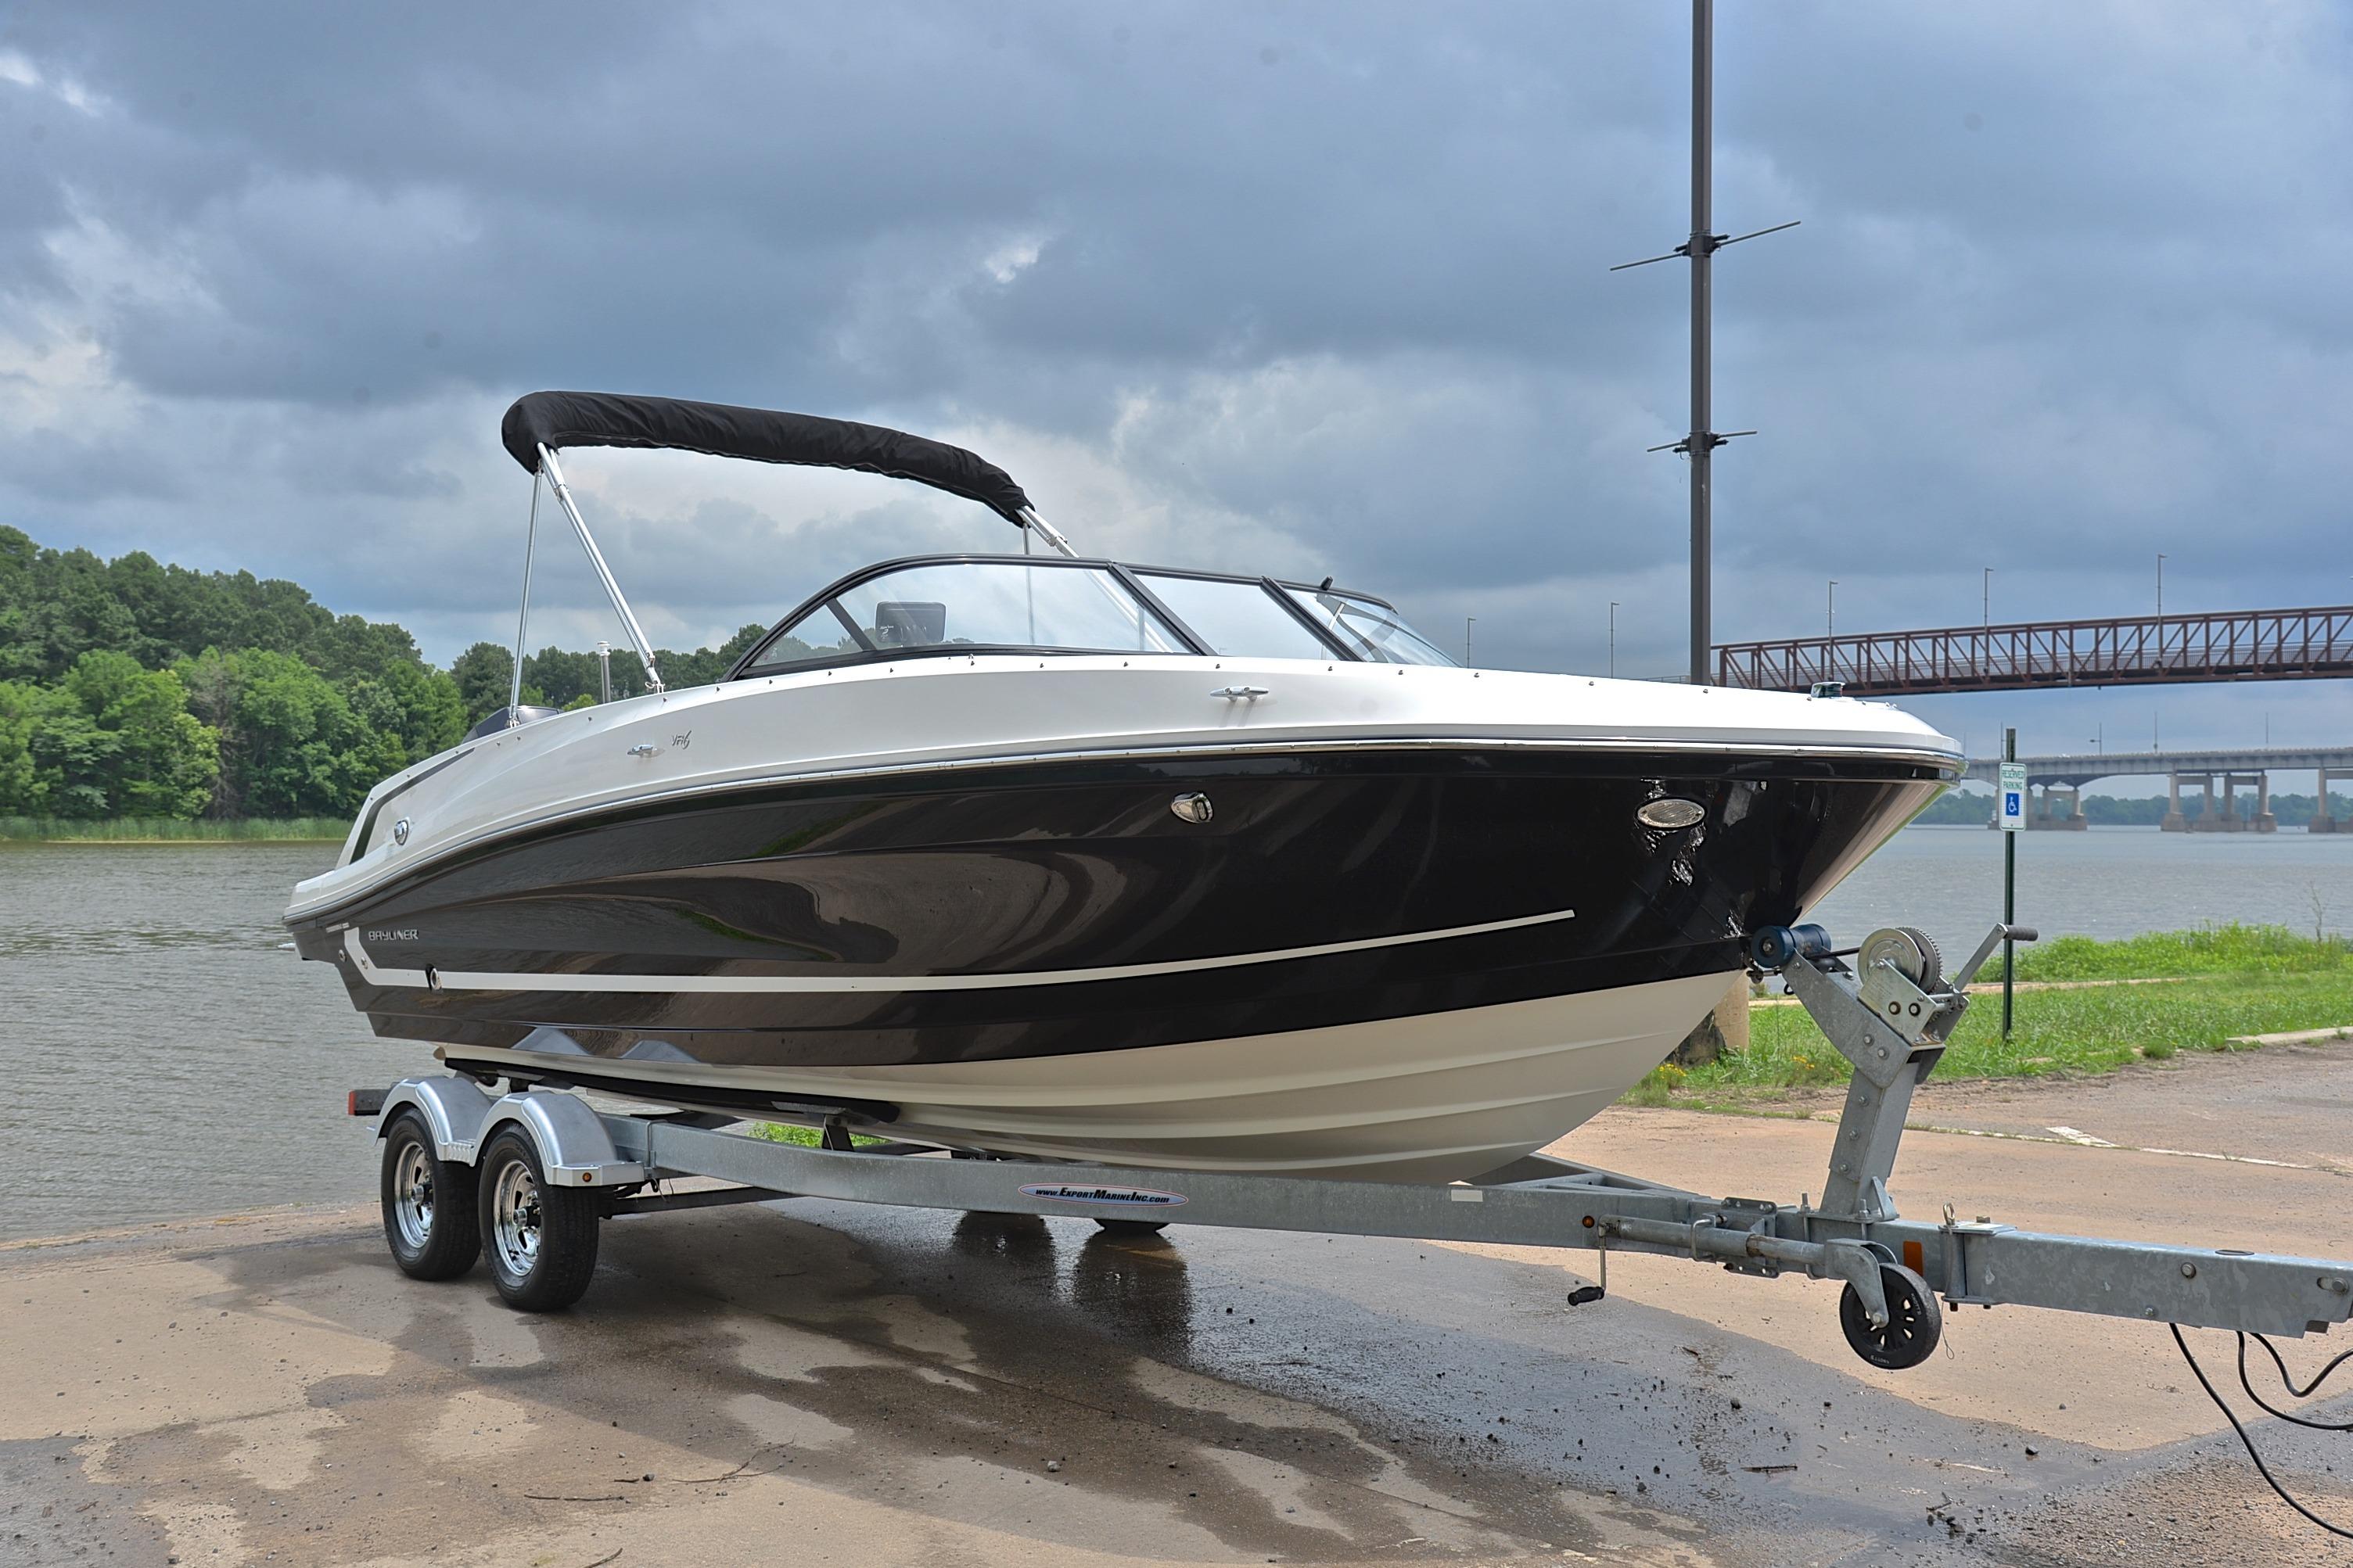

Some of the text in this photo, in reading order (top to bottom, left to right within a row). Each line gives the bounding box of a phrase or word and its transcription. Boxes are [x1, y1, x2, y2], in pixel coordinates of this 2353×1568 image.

[2002, 770, 2024, 779] RESERVED
[2003, 780, 2022, 790] PARKING
[368, 929, 419, 941] BAYLINER
